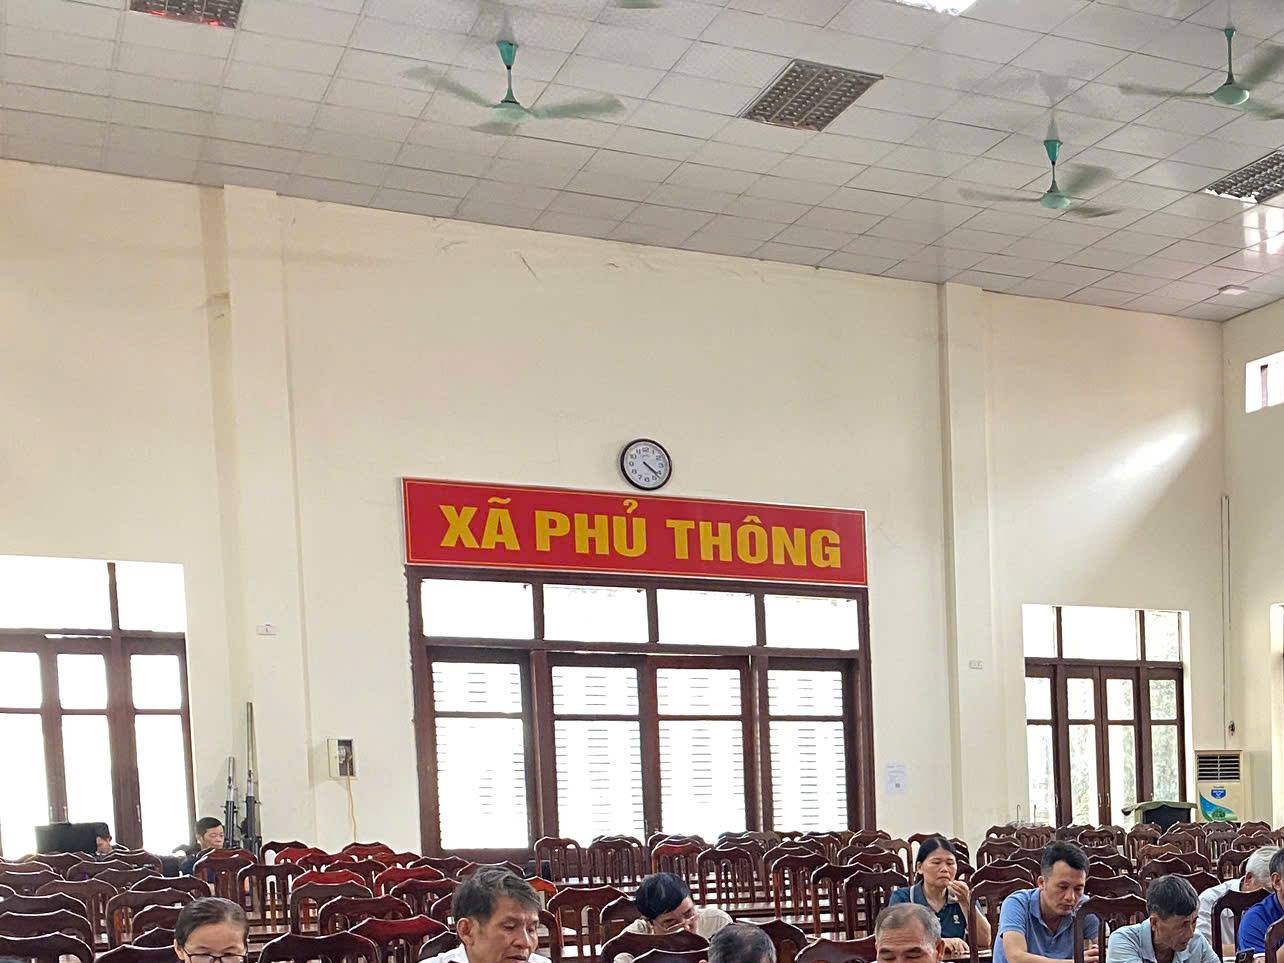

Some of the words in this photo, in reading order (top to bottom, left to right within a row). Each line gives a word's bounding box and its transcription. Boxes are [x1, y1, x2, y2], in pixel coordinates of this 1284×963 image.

[440, 497, 520, 551] XÃ
[535, 499, 647, 558] PHỦ
[666, 515, 842, 569] THÔNG
